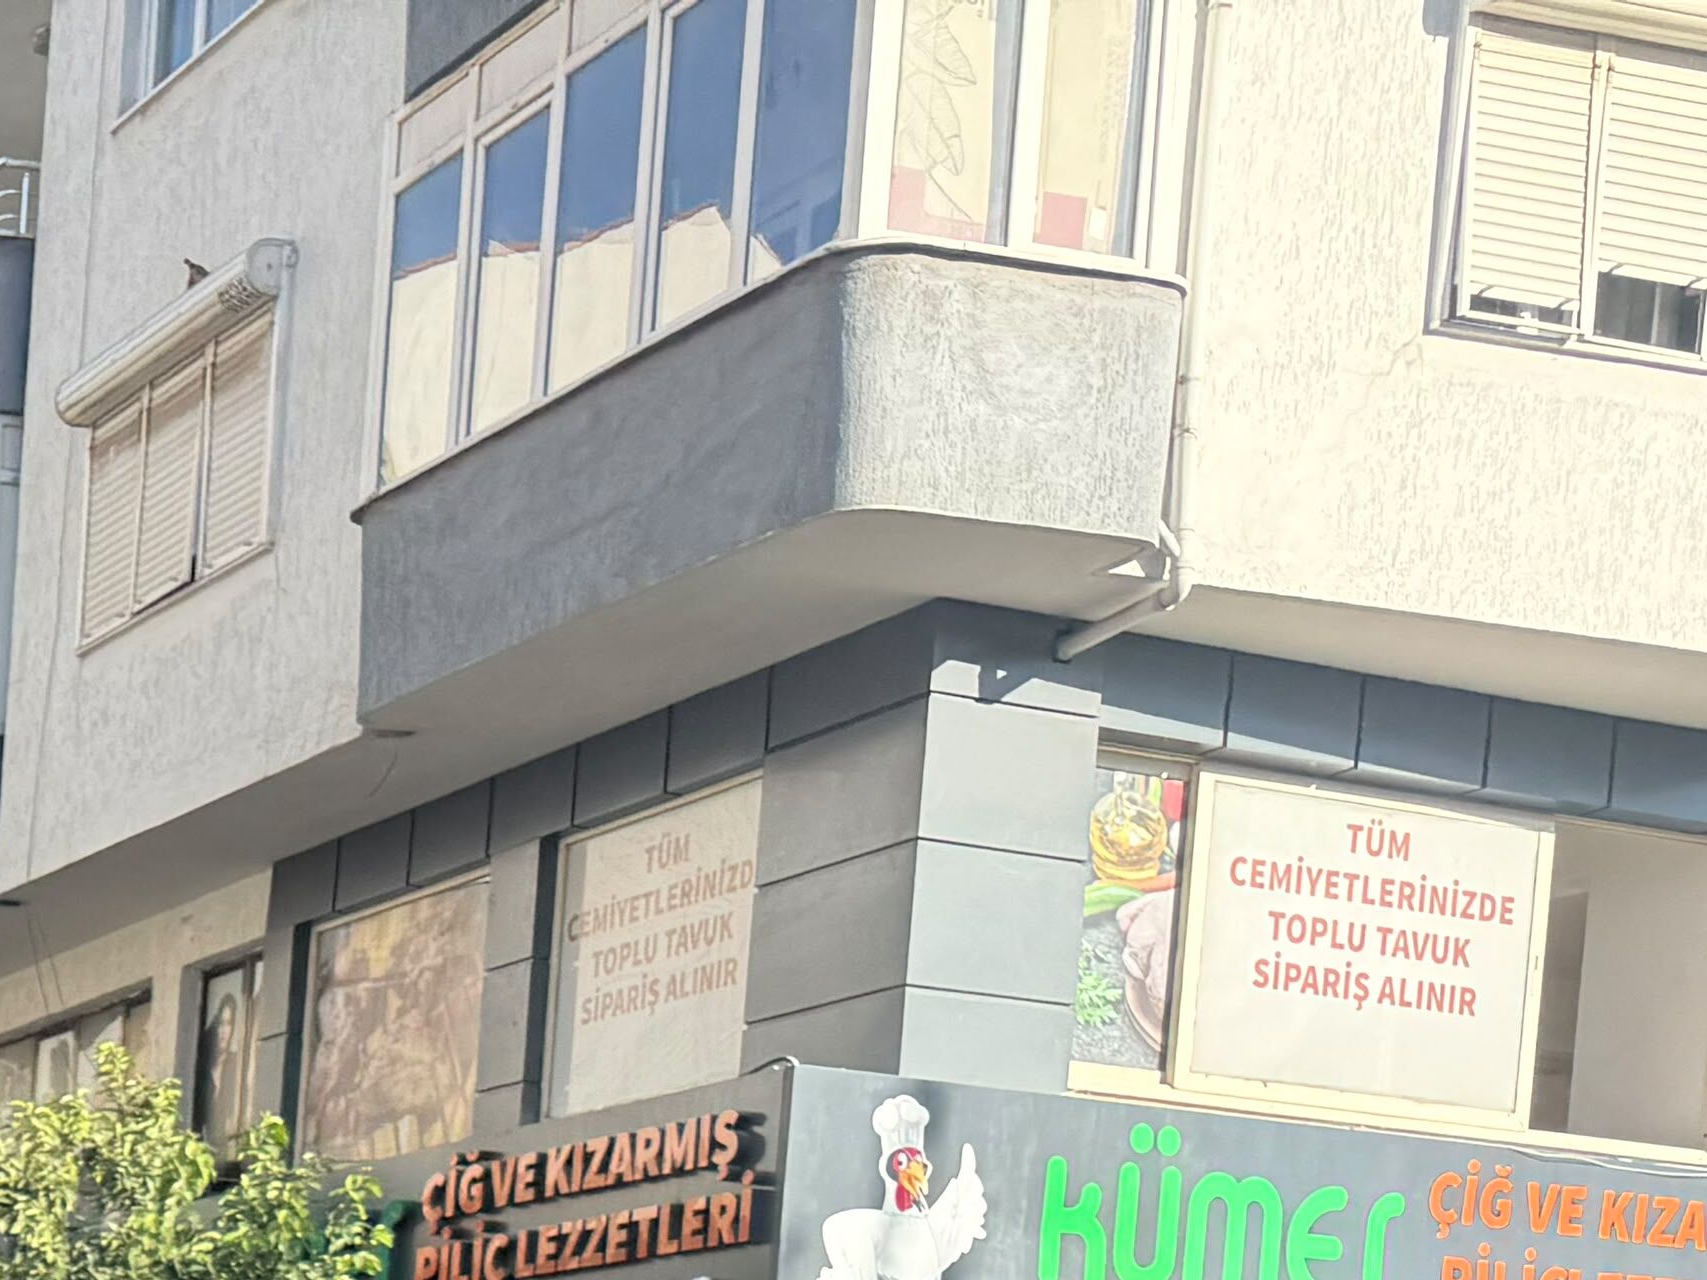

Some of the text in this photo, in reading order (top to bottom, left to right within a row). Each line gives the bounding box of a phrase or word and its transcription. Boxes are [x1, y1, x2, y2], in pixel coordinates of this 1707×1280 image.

[644, 832, 692, 874] TÜM
[1348, 818, 1412, 862] TÜM
[567, 858, 753, 943] CEMİYETLERİNİZD
[1229, 856, 1516, 926] CEMİYETLERİNİZDE
[592, 911, 734, 978] TOPLU TAVUK
[1268, 910, 1471, 968] TOPLU TAVUK
[580, 957, 738, 1026] SİPARİŞ ALINIR
[1252, 951, 1477, 1017] SİPARİŞ ALINIR
[421, 1109, 740, 1235] ÇİĞ VE KIZARMIŞ
[1428, 1158, 1707, 1251] ÇİĞ VE KIZA
[514, 1169, 755, 1279] LEZZETLERİ
